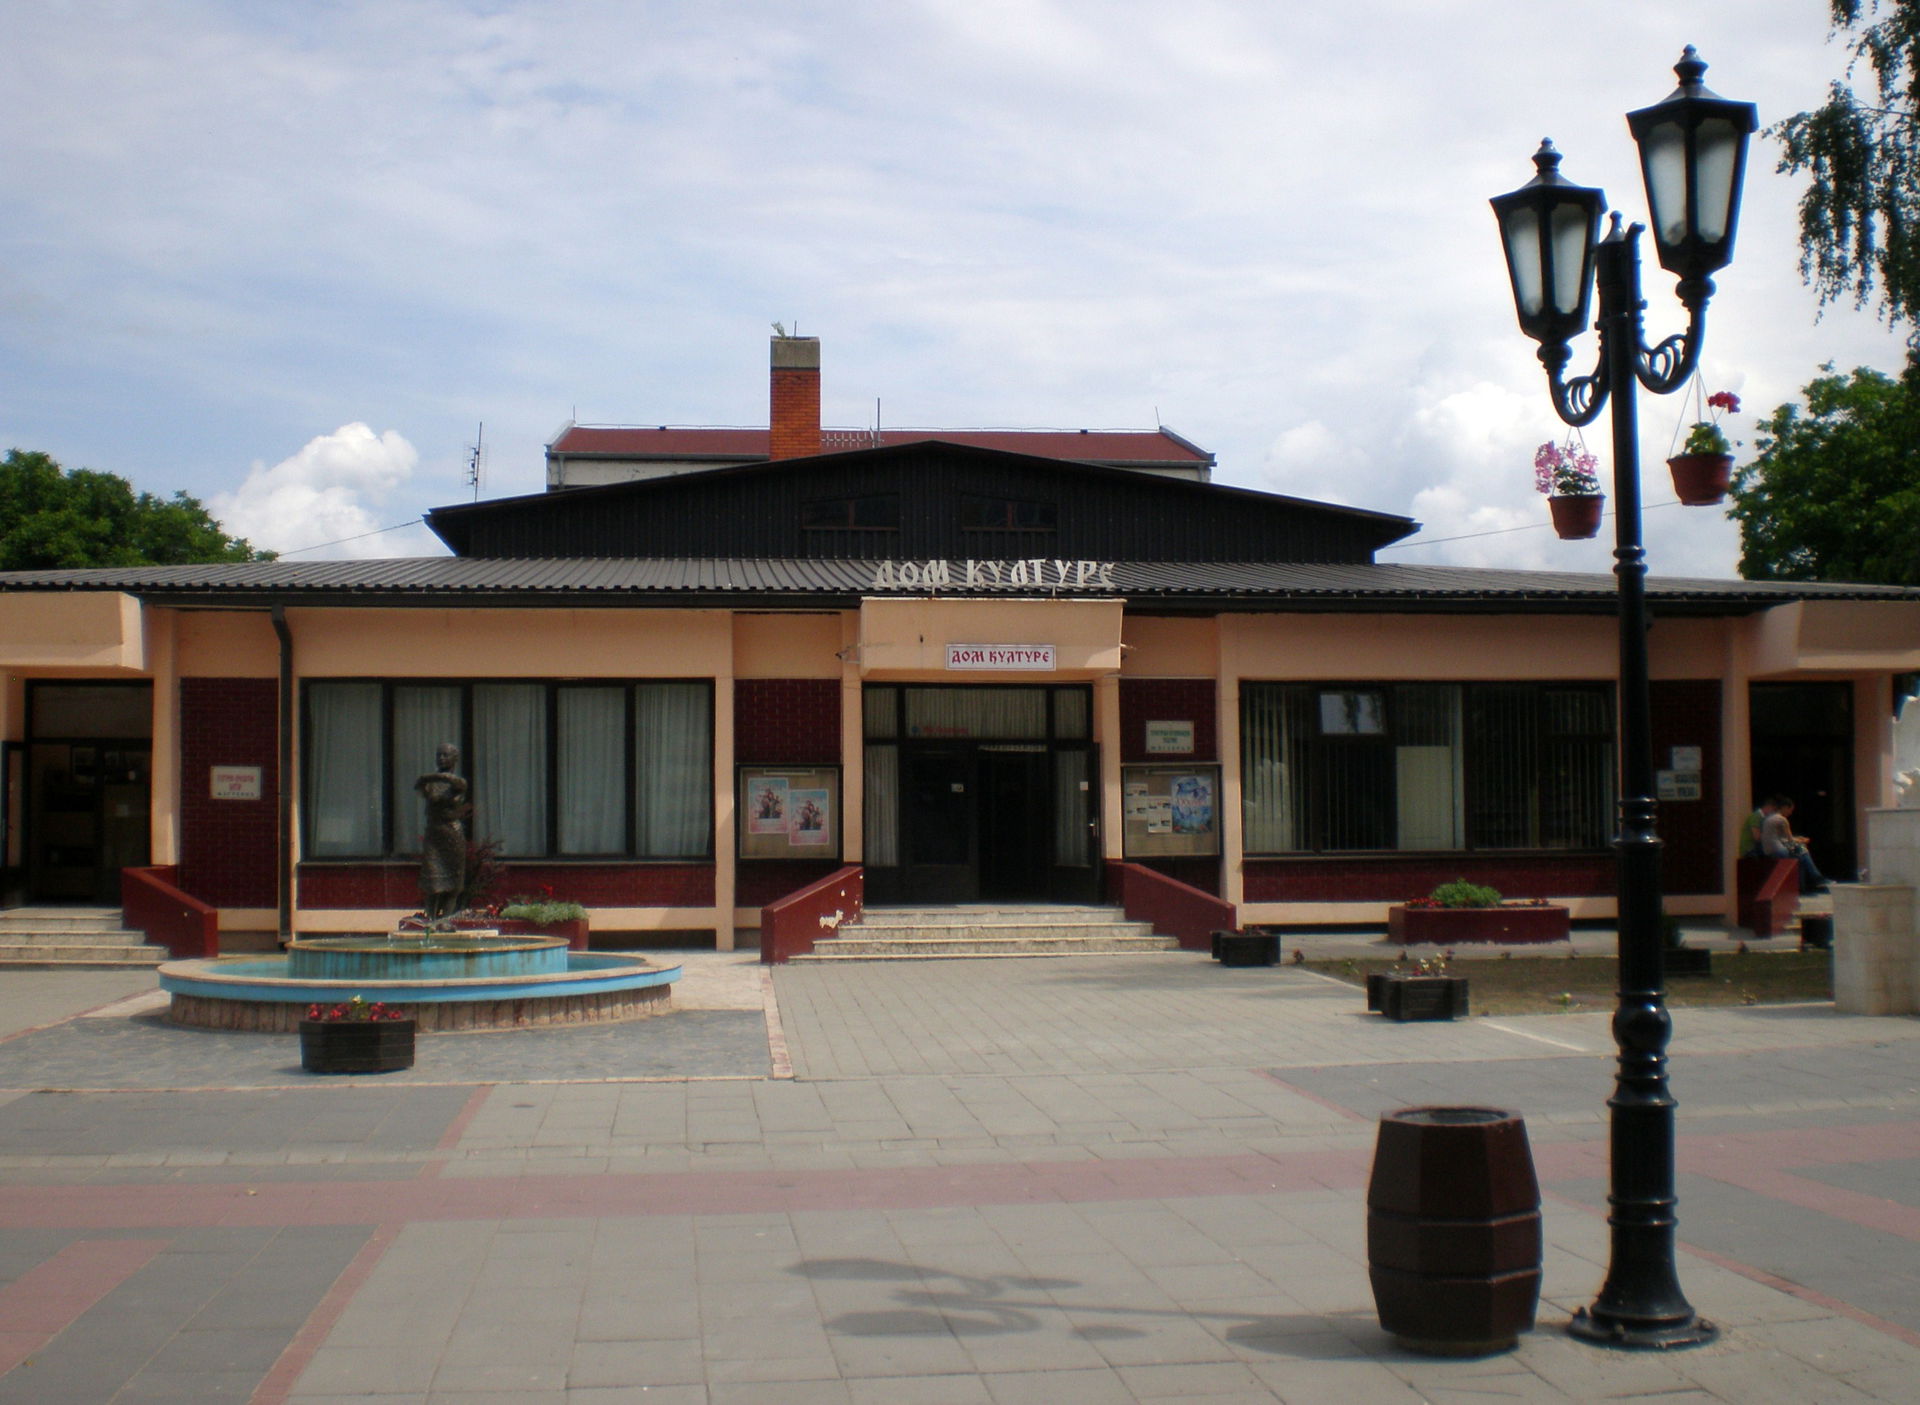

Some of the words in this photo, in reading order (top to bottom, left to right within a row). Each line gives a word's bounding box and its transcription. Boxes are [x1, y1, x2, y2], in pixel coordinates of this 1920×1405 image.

[872, 559, 950, 591] ДОМ
[967, 558, 1117, 589] КУЛТУРЕ
[952, 650, 985, 664] ДОМ
[989, 650, 1050, 664] КУЛТУРЕ
